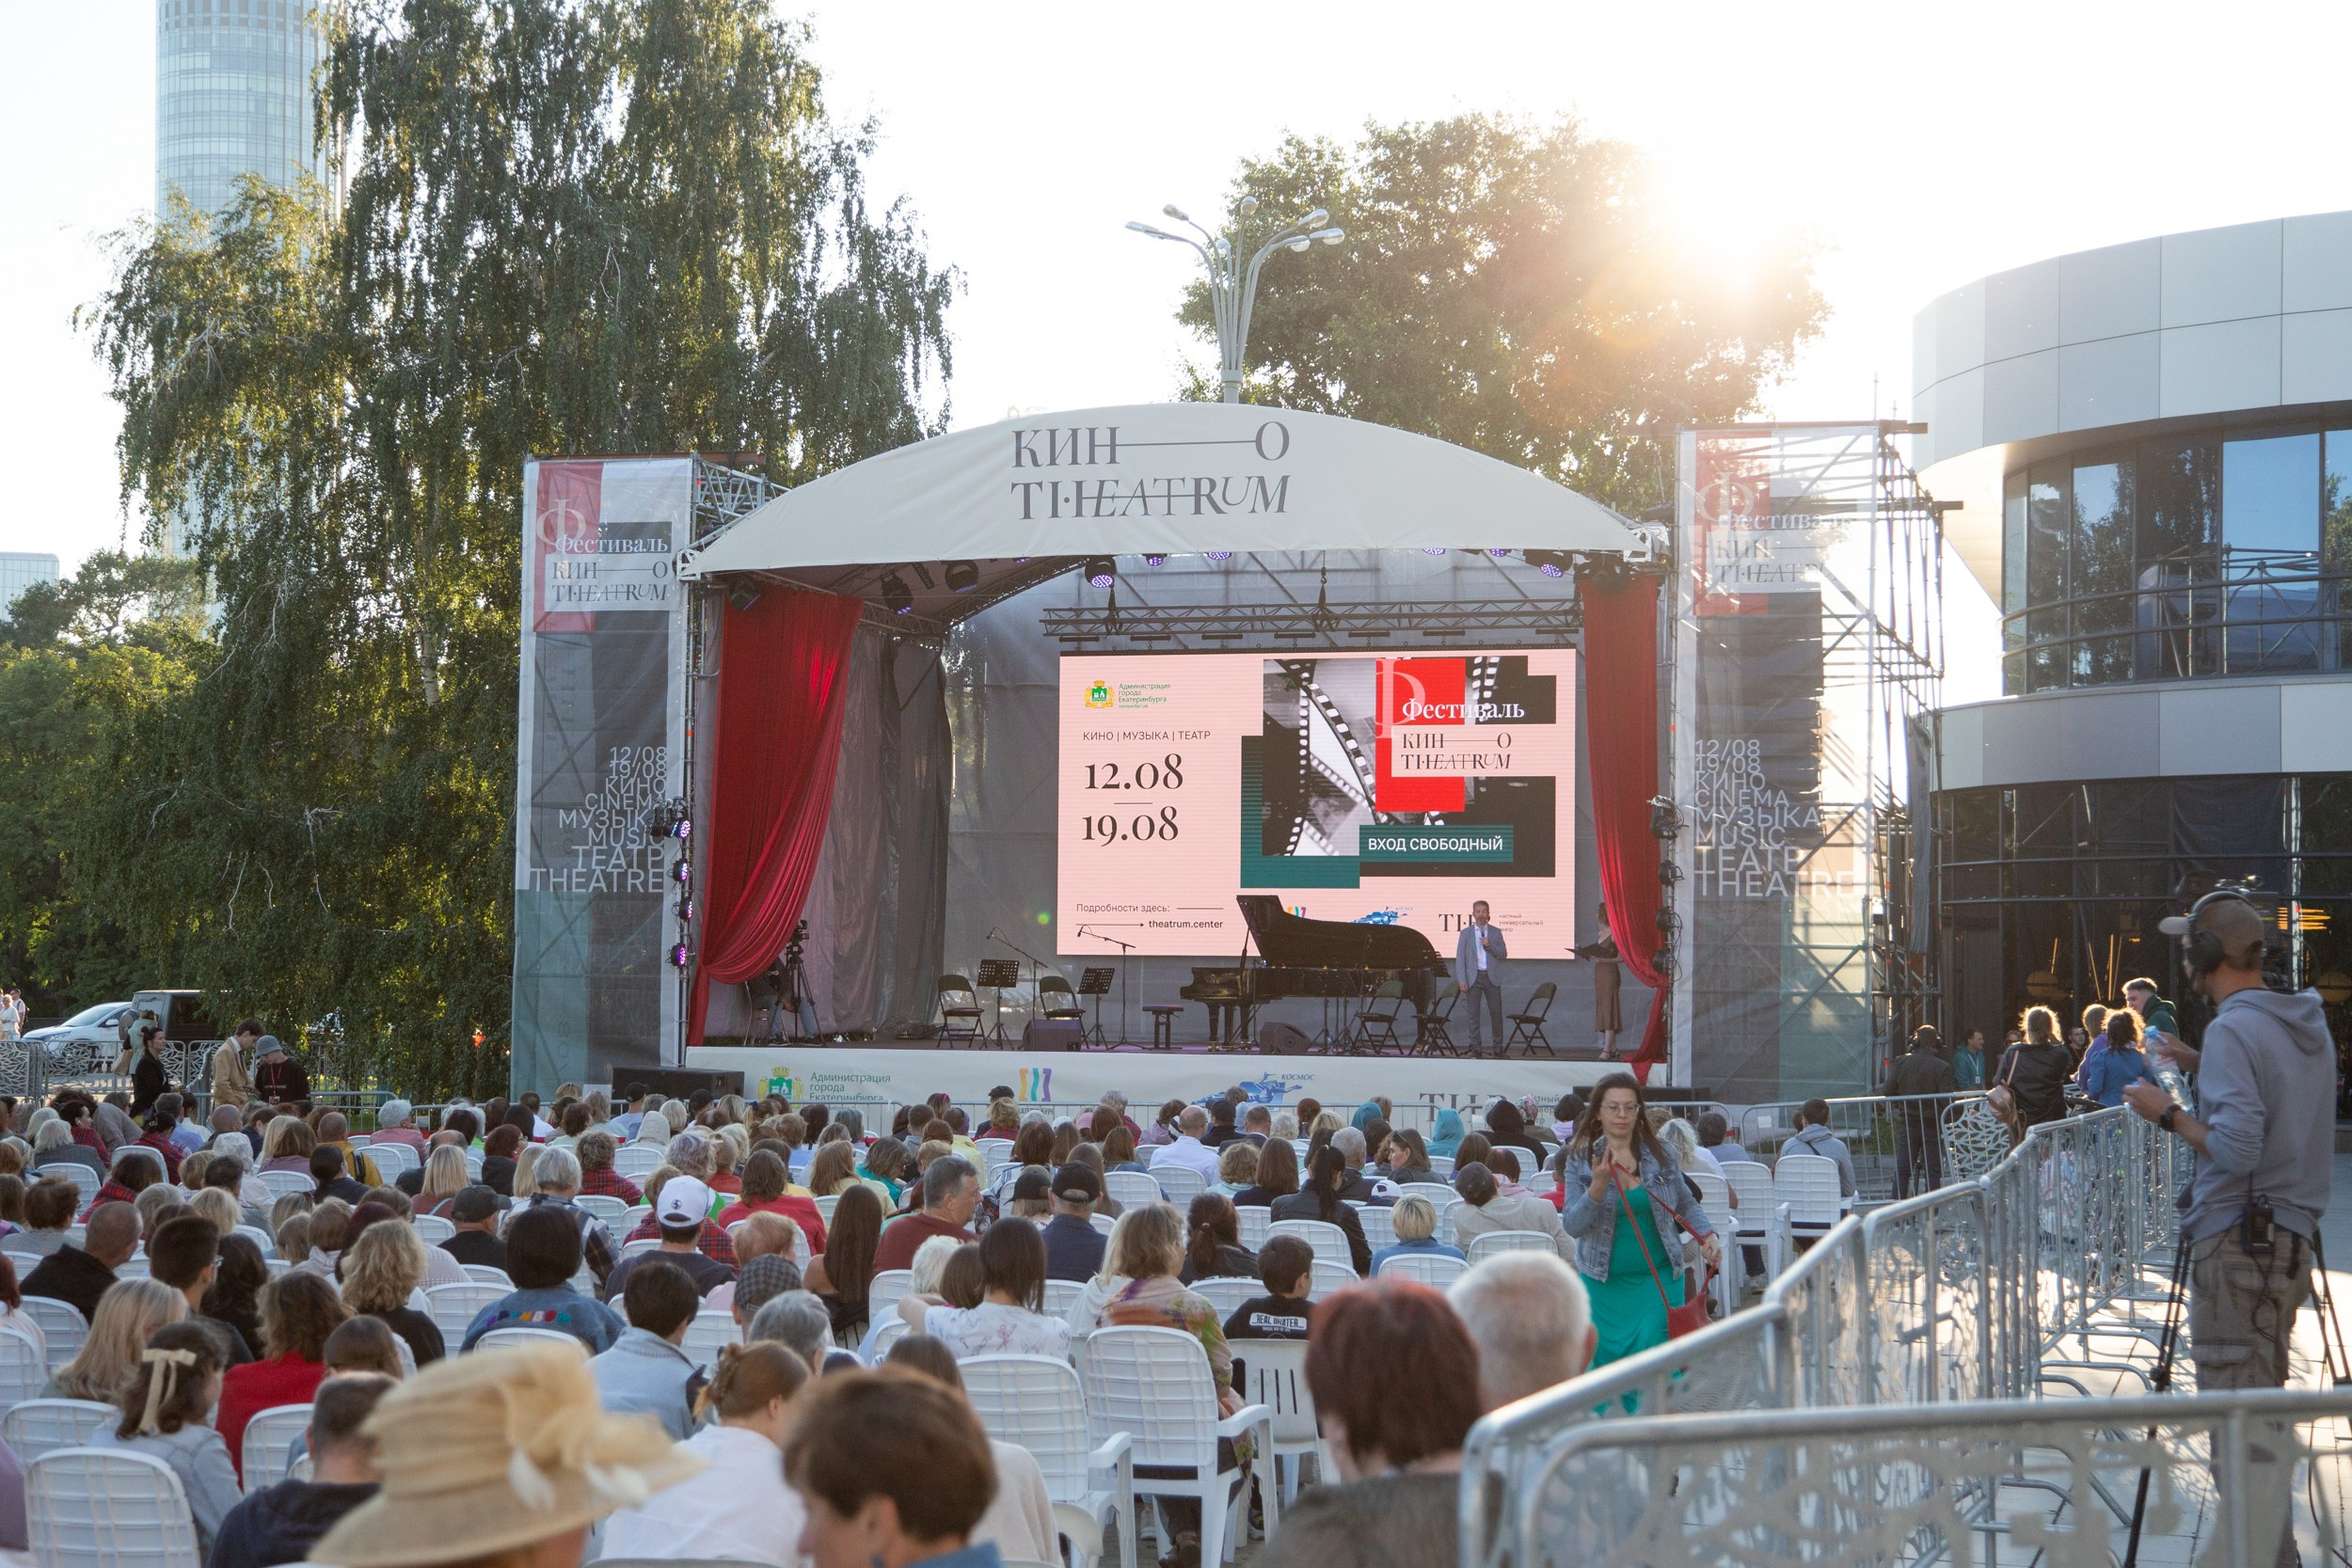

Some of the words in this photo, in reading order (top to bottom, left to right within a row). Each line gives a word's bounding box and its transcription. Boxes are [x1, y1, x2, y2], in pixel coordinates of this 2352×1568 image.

[1718, 510, 1851, 531] Фестиваь
[555, 534, 668, 554] Фестиваль
[1402, 698, 1525, 721] Фестиваль
[1083, 732, 1114, 740] КИНО
[1122, 731, 1169, 740] МУЗЫКА
[1178, 731, 1211, 739] ТЕАТР
[610, 746, 667, 767] 12/08
[1694, 739, 1760, 760] 12/08
[609, 762, 667, 782] 19/08
[1085, 753, 1184, 789] 12.08
[1694, 755, 1761, 774] 19/08
[605, 777, 666, 795] КИНО
[1695, 772, 1766, 790] КИНО
[1694, 789, 1789, 808] CINEMA
[559, 809, 650, 829] МУЗЫК
[1082, 806, 1179, 847] 19.08
[1695, 806, 1821, 827] МУЗЫКА
[1368, 838, 1406, 852] ВХОД
[1409, 835, 1503, 852] СВОБОДНЫЙ
[1695, 826, 1786, 847] MUSIC
[572, 846, 664, 869] ТЕАТР
[1694, 846, 1805, 872] ТЕАТР
[530, 868, 664, 893] THEATRE
[1694, 870, 1854, 896] THEATRE
[1076, 904, 1138, 913] Подробности
[1140, 904, 1170, 912] здесь:
[809, 1084, 845, 1092] города
[810, 1072, 891, 1084] Администрация
[1256, 1314, 1272, 1324] REAL
